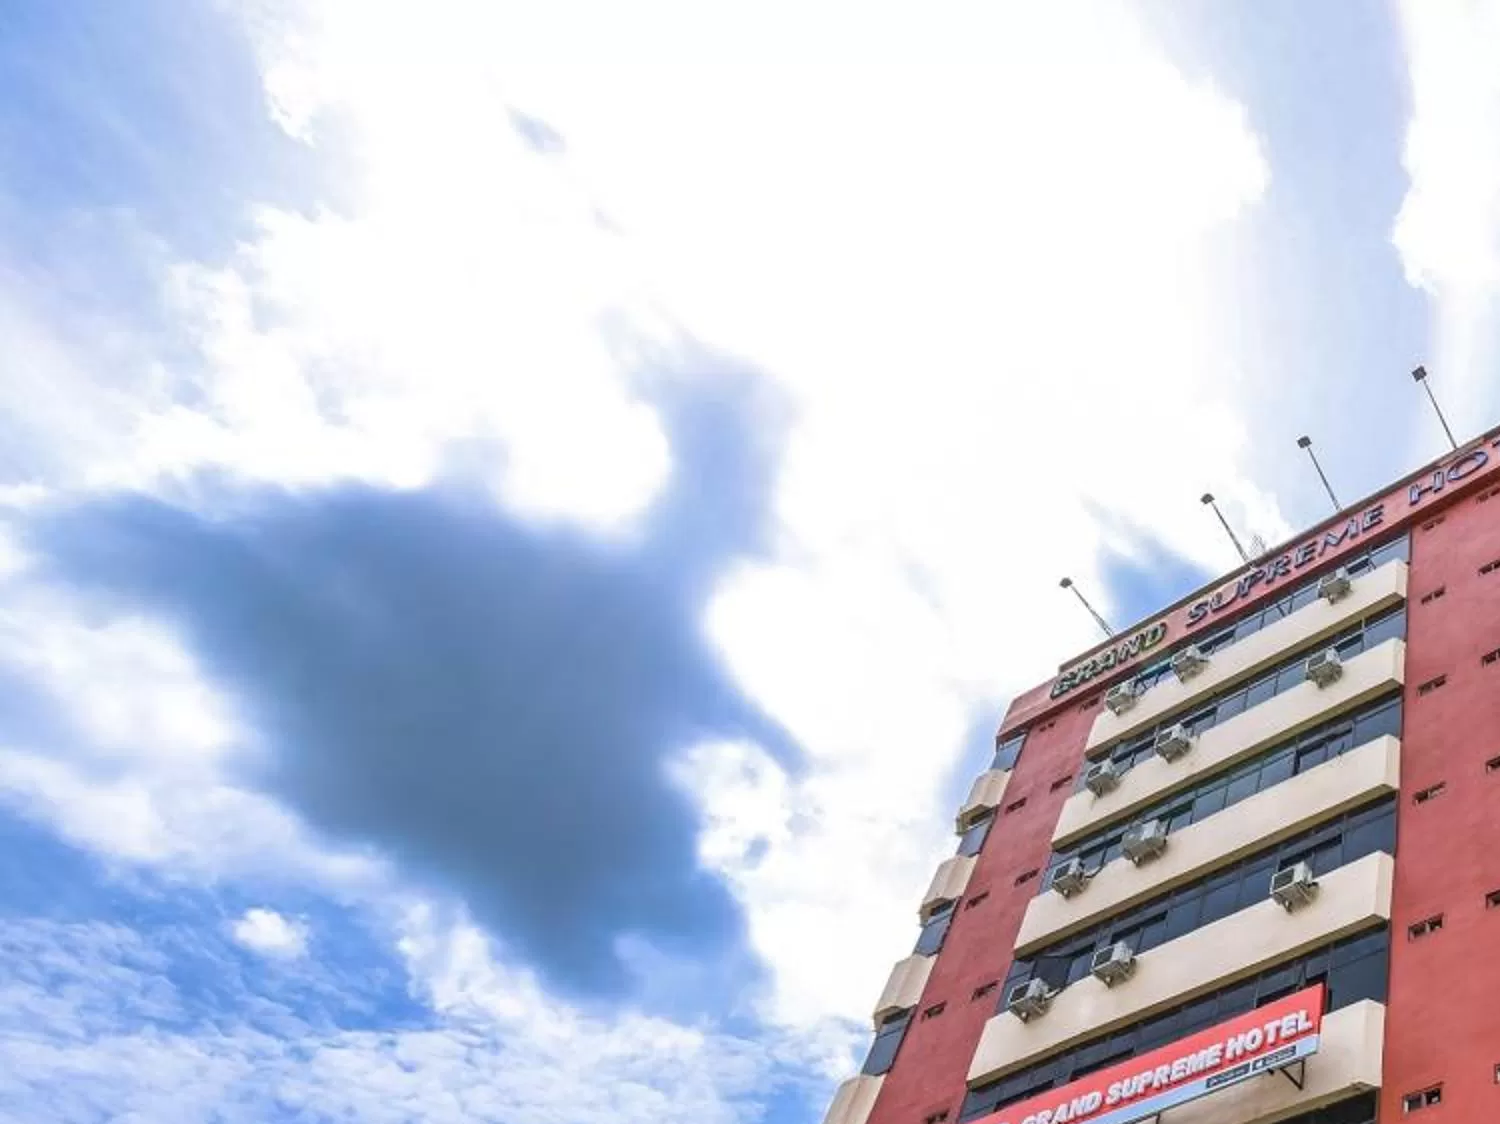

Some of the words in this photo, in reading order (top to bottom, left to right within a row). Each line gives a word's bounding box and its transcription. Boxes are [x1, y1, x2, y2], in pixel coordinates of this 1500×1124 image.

[1050, 621, 1168, 699] GRAND
[1185, 503, 1385, 628] SUPREME
[1106, 1042, 1224, 1106] SUPREME
[1224, 1009, 1314, 1060] HOTEL
